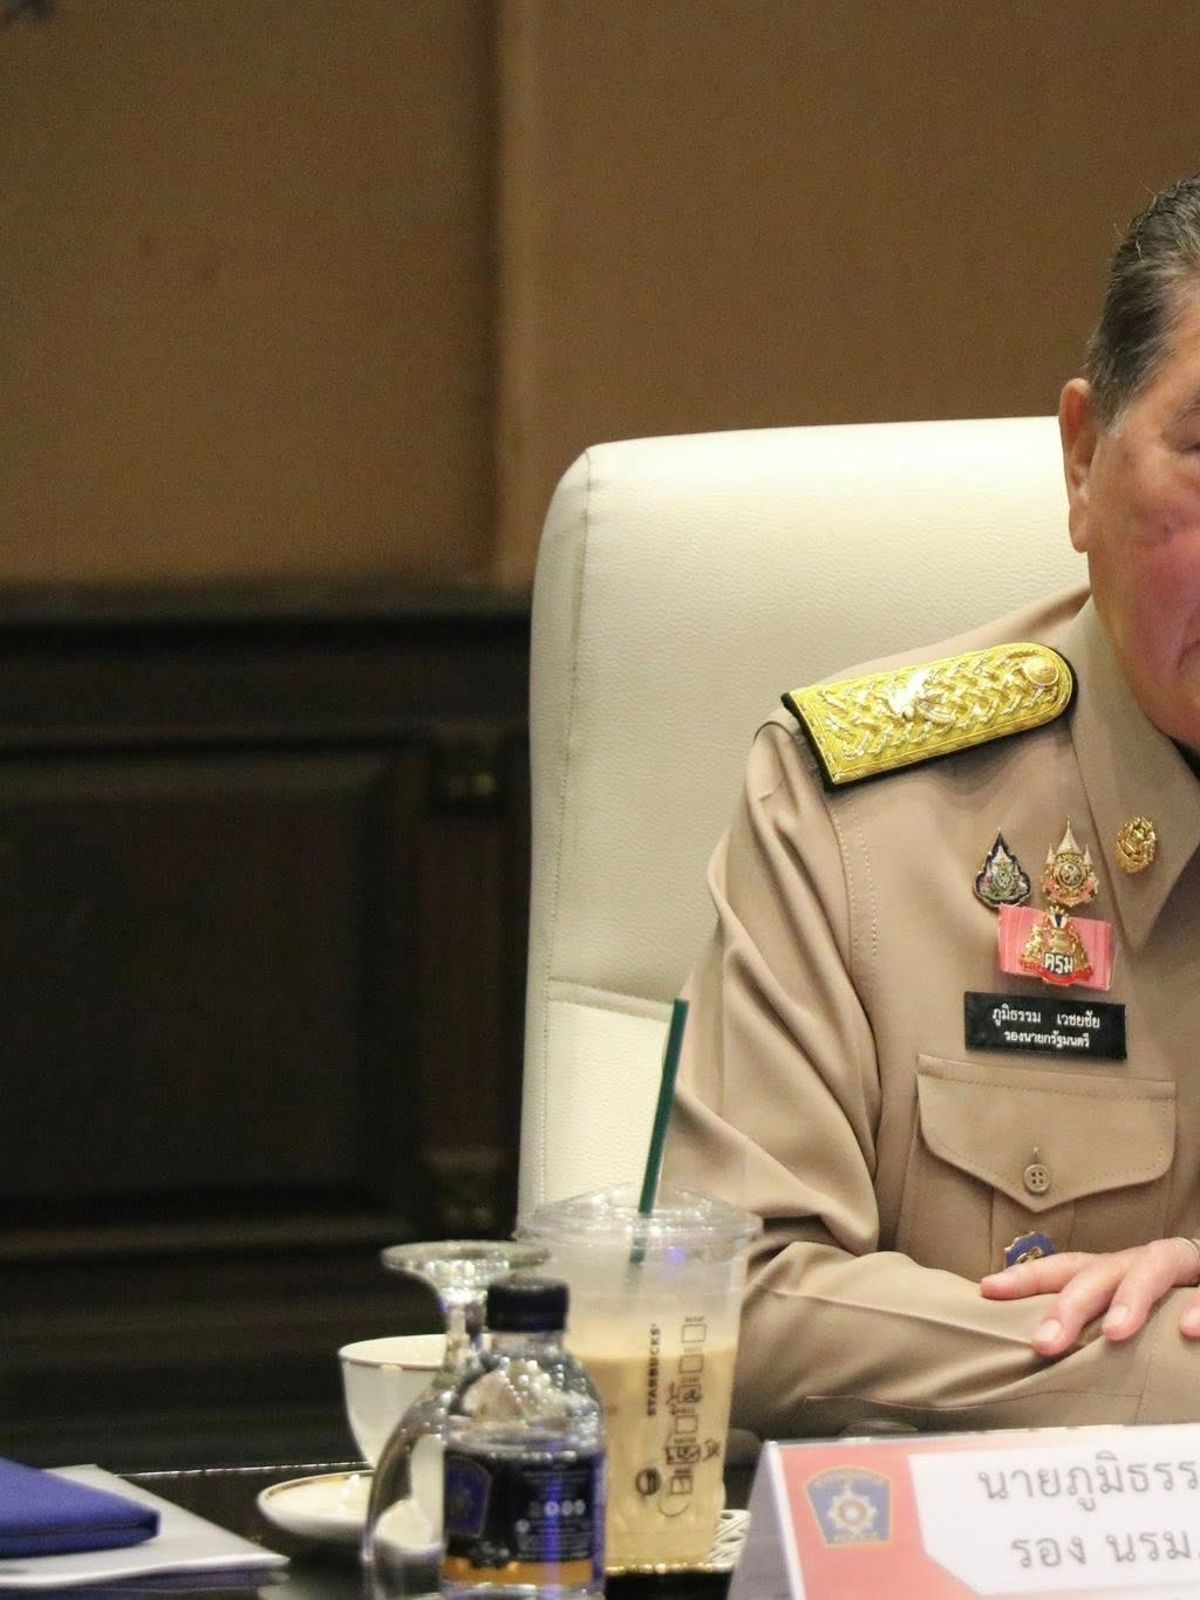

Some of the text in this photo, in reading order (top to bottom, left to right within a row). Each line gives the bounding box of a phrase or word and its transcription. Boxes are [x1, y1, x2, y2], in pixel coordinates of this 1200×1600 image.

[992, 1003, 1100, 1029] ภูมิธรรม เวชยชัย
[1003, 1030, 1090, 1049] รองนายกรัฐมนตรี
[645, 1327, 660, 1417] STARBUCKS
[1010, 1536, 1088, 1569] รอง
